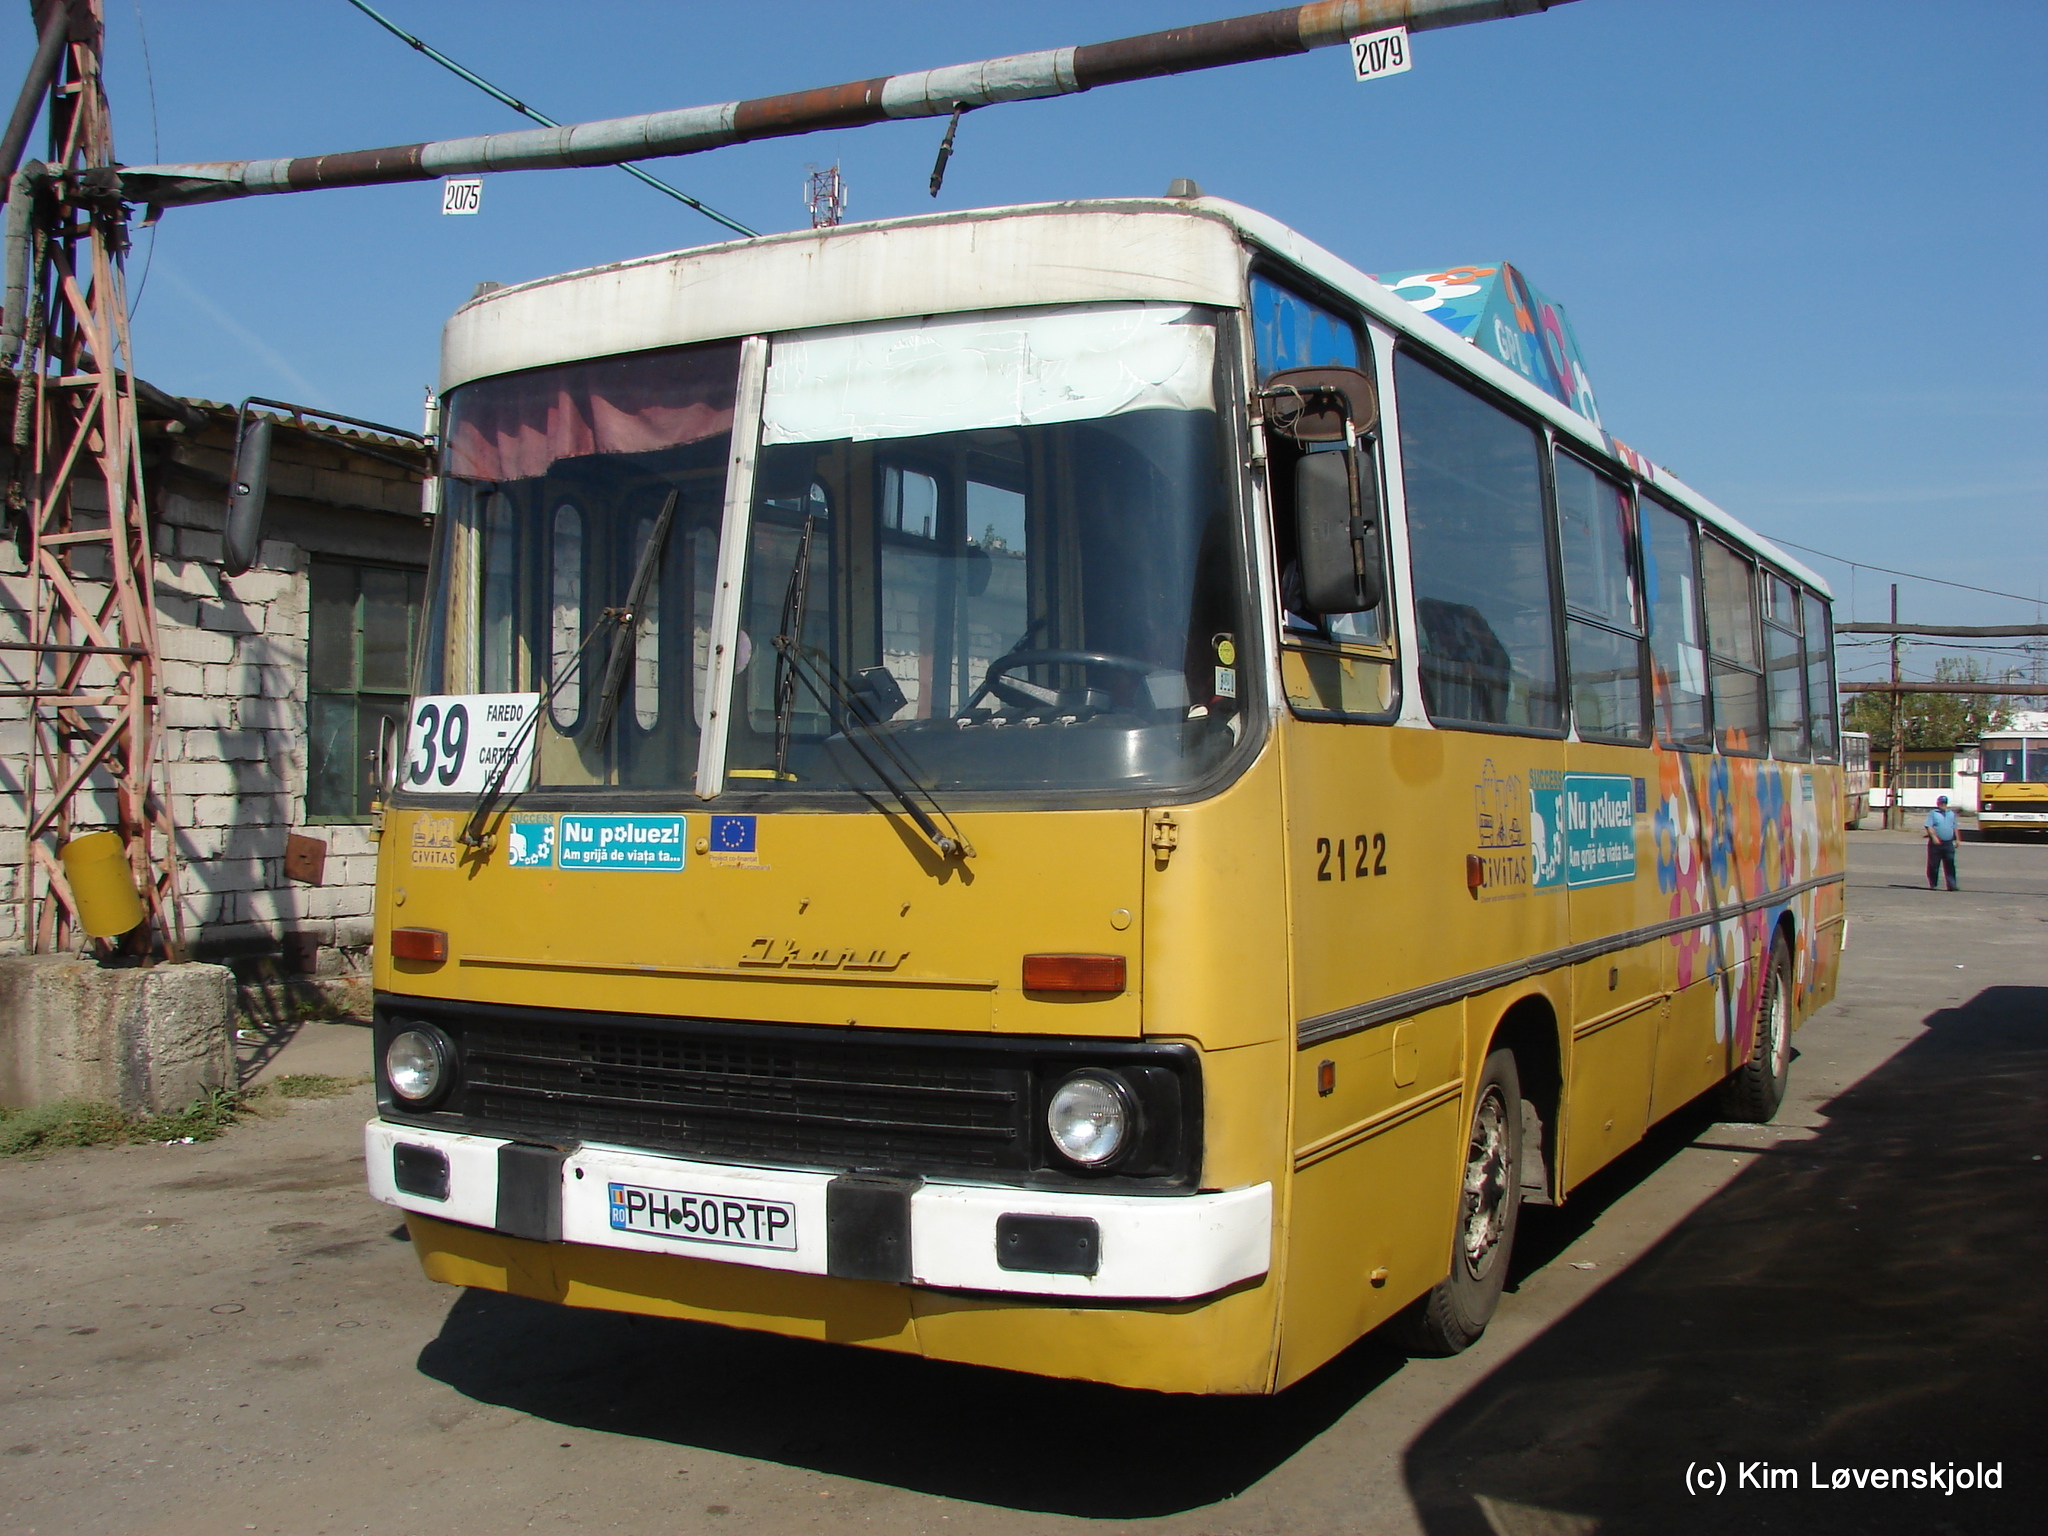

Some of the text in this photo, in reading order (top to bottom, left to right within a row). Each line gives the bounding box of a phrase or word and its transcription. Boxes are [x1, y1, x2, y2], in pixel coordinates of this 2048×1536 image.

[1356, 35, 1404, 76] 2079
[446, 185, 480, 210] 2075
[1494, 318, 1529, 375] GPL
[486, 704, 524, 722] FAREDO
[411, 703, 470, 786] 39
[510, 813, 554, 824] SUCCESS
[1567, 791, 1632, 839] Nu poluez!
[565, 822, 680, 848] Nu poluez!
[563, 848, 581, 861] Am
[583, 848, 608, 864] grijă
[610, 849, 624, 861] de
[1316, 833, 1387, 881] 2122
[1597, 842, 1606, 863] de
[612, 1208, 625, 1223] RO
